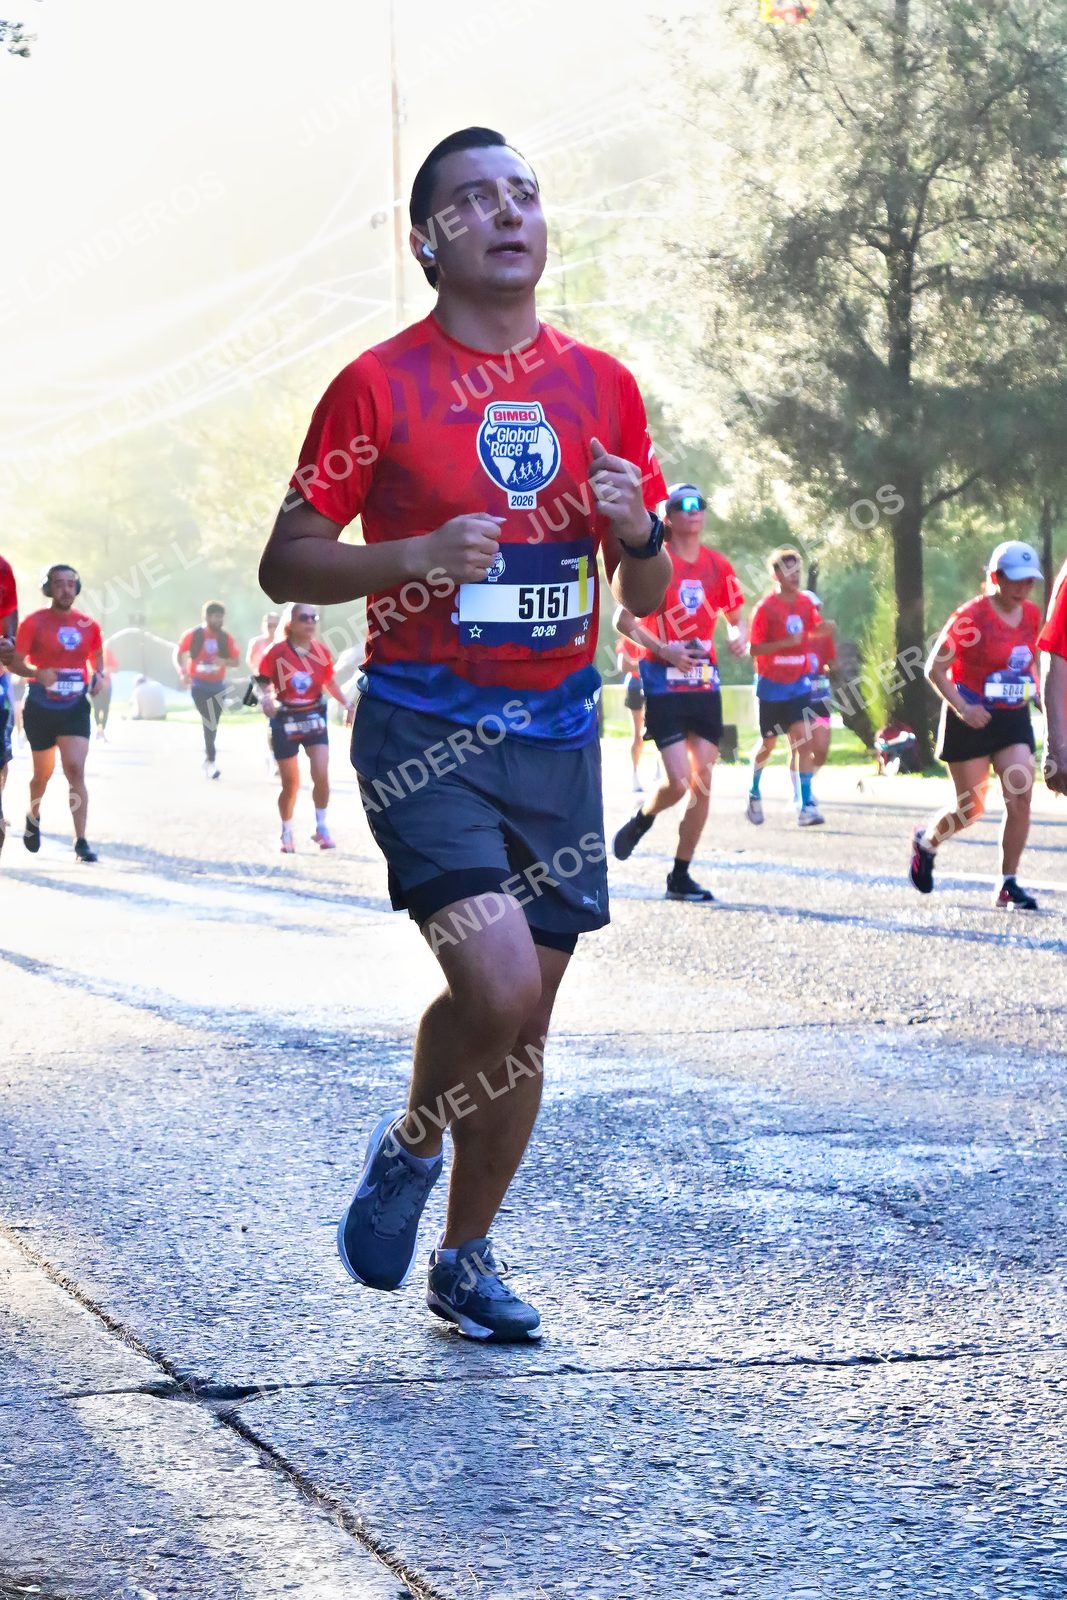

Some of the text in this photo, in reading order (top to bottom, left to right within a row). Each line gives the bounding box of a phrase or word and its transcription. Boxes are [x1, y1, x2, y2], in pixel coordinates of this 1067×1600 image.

[493, 410, 538, 421] BIMBO
[497, 427, 538, 443] Global
[491, 442, 523, 456] Race
[511, 495, 534, 506] 2026
[518, 585, 569, 620] 5151
